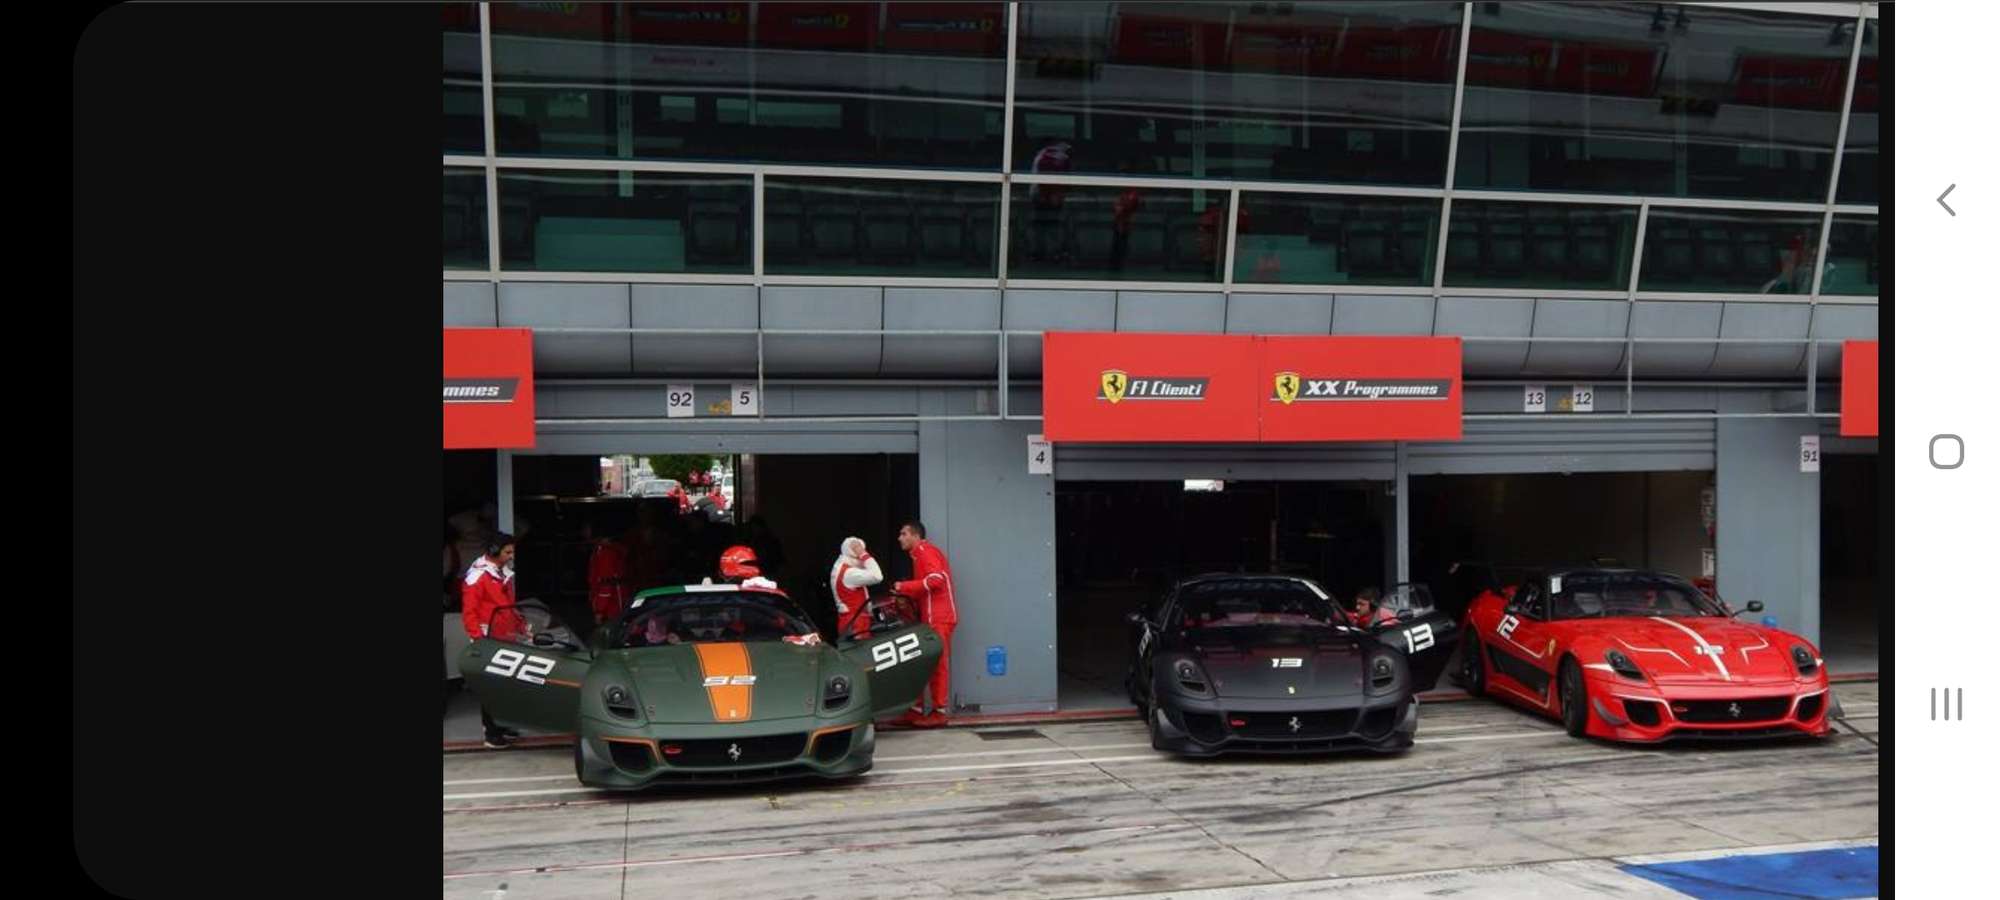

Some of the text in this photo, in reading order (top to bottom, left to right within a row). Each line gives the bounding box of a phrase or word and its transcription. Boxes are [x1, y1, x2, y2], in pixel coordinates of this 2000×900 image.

[1129, 380, 1203, 396] F1 Clienti
[1305, 380, 1439, 400] XX Programmes
[670, 392, 692, 407] 92
[740, 391, 750, 405] 5
[1527, 391, 1544, 405] 13
[1575, 391, 1592, 405] 12
[1035, 450, 1045, 465] 4
[1803, 449, 1818, 463] 91
[1496, 614, 1520, 640] 12
[1403, 623, 1435, 654] 13
[872, 633, 922, 672] 92
[485, 648, 556, 685] 92
[1271, 658, 1303, 668] 13
[703, 675, 757, 687] 92
